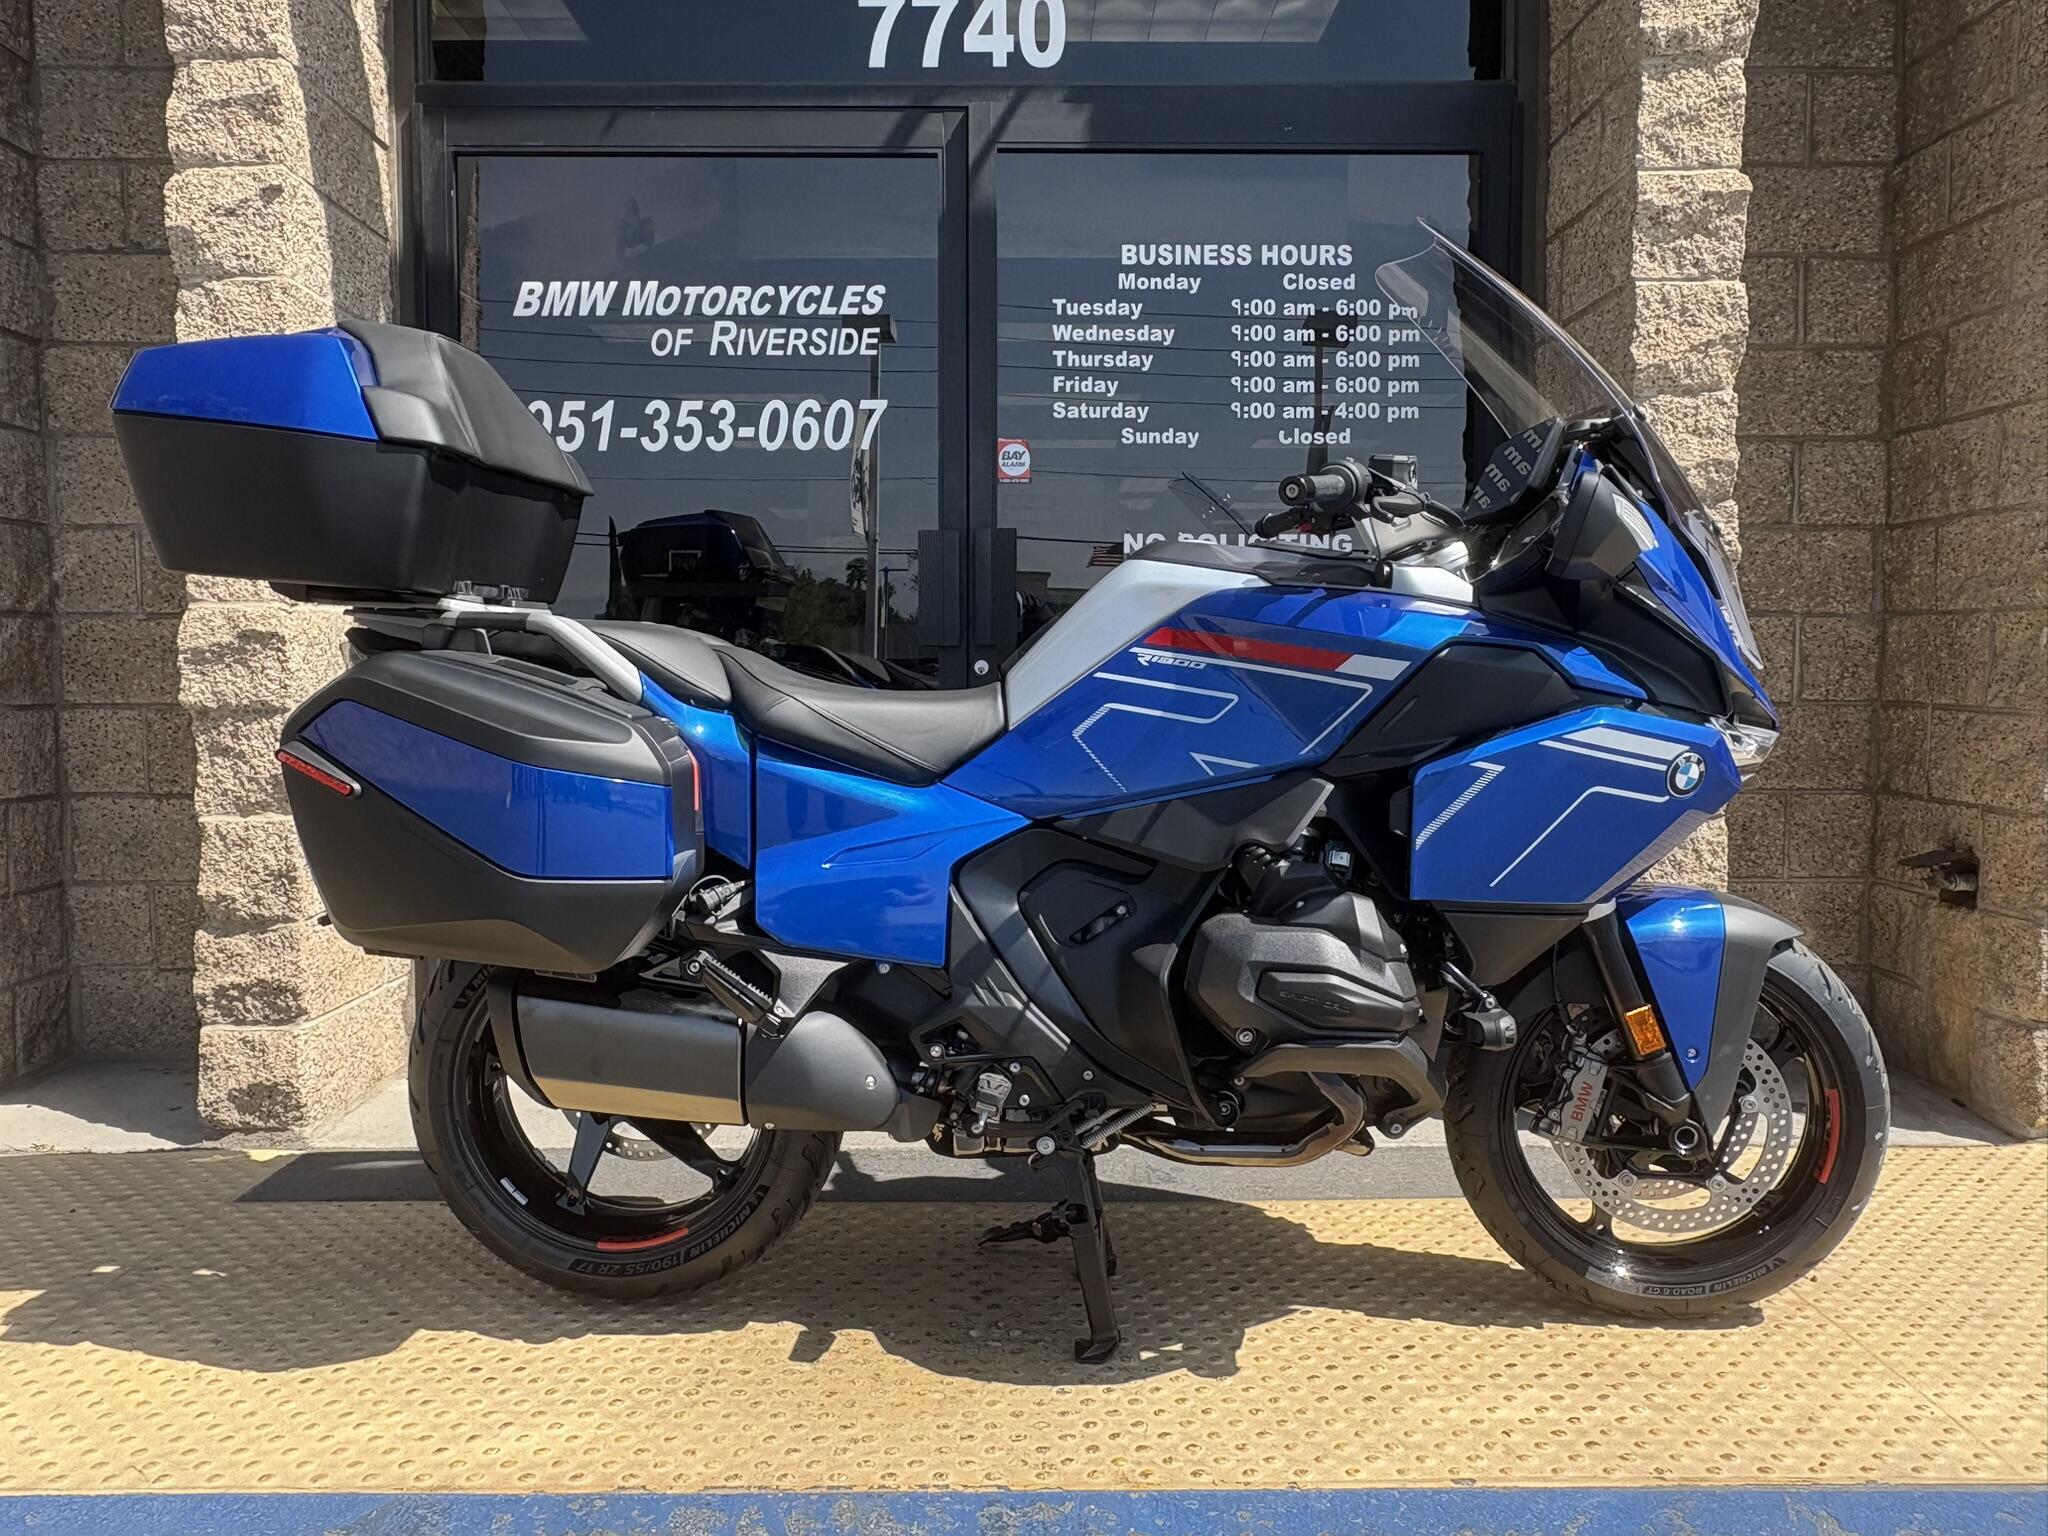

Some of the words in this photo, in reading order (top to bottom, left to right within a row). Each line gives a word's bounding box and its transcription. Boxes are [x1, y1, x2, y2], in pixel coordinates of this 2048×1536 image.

[858, 0, 1066, 68] 7740
[1121, 244, 1252, 266] BUSINESS
[1261, 244, 1353, 266] HOURS
[1118, 273, 1201, 294] Monday
[1283, 273, 1355, 290] Closed
[512, 281, 618, 317] BMW
[622, 280, 886, 316] MOTORCYCLES
[1052, 299, 1143, 320] Tuesday
[1231, 299, 1276, 316] 9:00
[1283, 303, 1315, 316] am
[1335, 299, 1381, 316] 6:00
[1388, 303, 1418, 320] pm
[710, 320, 881, 357] RIVERSIDE
[1052, 324, 1175, 345] Wednesday
[1231, 325, 1276, 341] 9:00
[1283, 329, 1315, 341] am
[1335, 325, 1381, 341] 6:00
[1388, 329, 1420, 345] pm
[1053, 351, 1153, 371] Thursday
[1231, 351, 1276, 367] 9:00
[1283, 355, 1315, 367] am
[1335, 351, 1381, 367] 6:00
[1388, 355, 1420, 371] pm
[1053, 376, 1119, 397] Friday
[1231, 376, 1276, 393] 9:00
[1283, 380, 1315, 393] am
[1335, 376, 1381, 393] 6:00
[1388, 380, 1420, 397] pm
[1053, 402, 1149, 423] Saturday
[1231, 402, 1276, 419] 9:00
[1283, 406, 1315, 419] am
[1334, 402, 1380, 419] 4:00
[1388, 406, 1419, 423] pm
[1121, 428, 1199, 448] Sunday
[1002, 450, 1026, 460] BAY
[1571, 1081, 1593, 1121] BMW
[689, 1206, 750, 1257] MICHELIN
[576, 1262, 594, 1271] 17
[599, 1263, 621, 1274] ZR
[623, 1257, 680, 1275] 190/55
[1713, 1268, 1768, 1291] MICHELIN
[1673, 1286, 1704, 1295] ROAD
